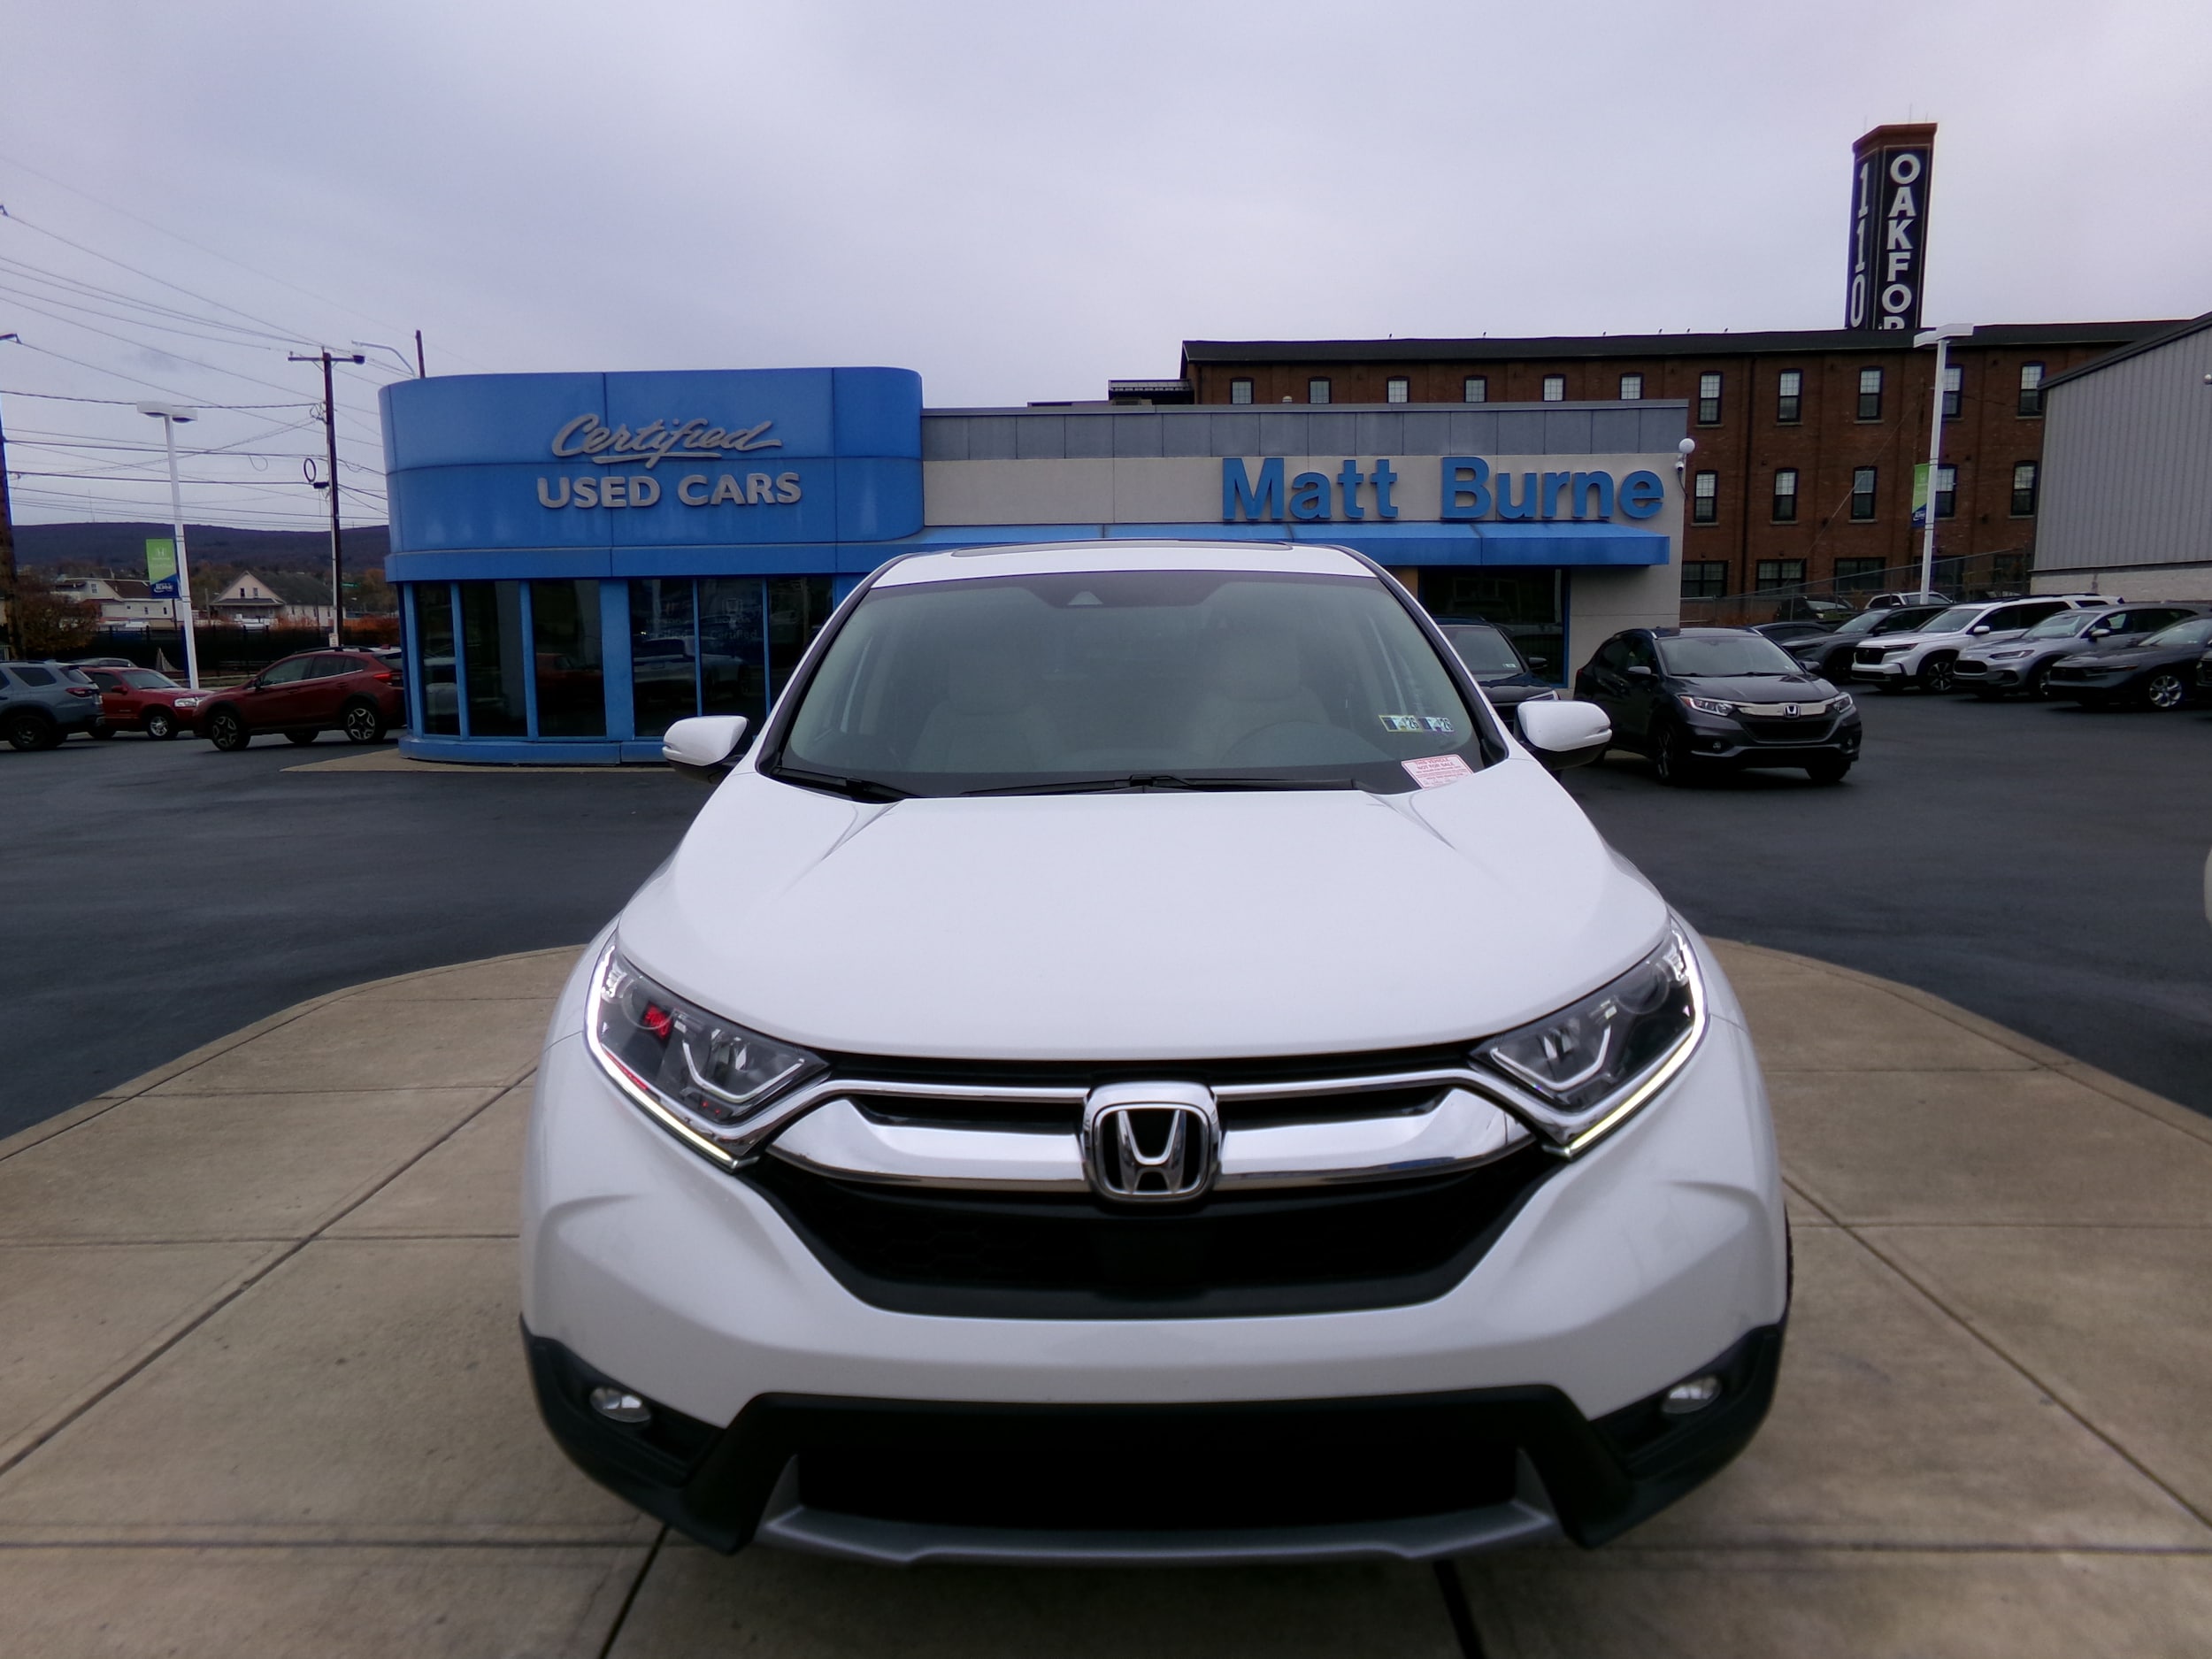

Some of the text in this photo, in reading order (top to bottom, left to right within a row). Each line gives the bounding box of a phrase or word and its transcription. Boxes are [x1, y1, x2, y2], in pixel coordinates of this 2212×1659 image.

[551, 413, 782, 469] Certified
[537, 472, 802, 509] USED CARS
[1222, 457, 1664, 520] Matt Burne
